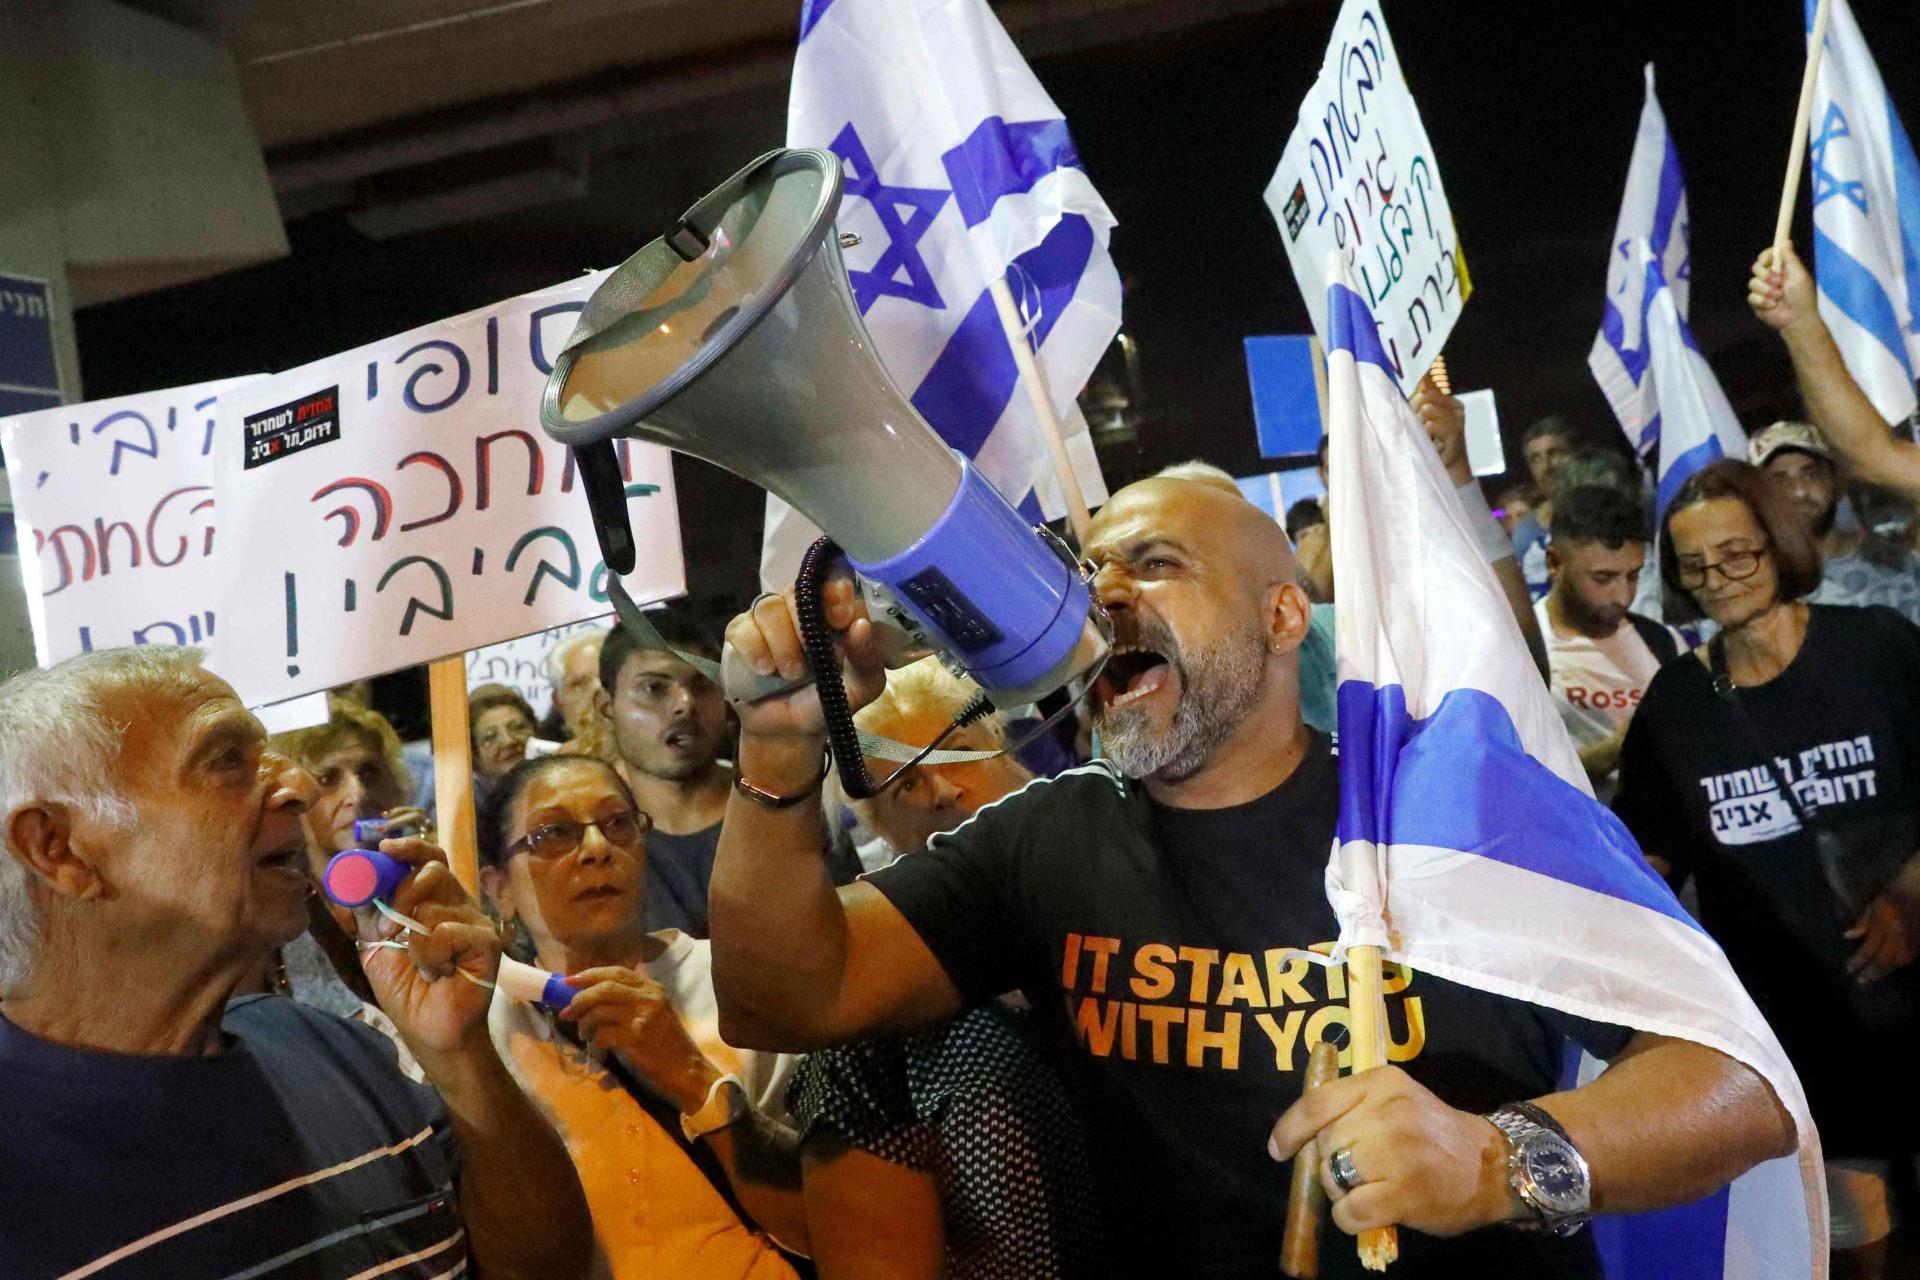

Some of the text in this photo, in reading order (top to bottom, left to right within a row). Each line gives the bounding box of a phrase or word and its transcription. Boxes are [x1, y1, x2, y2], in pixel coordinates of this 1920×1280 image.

[1309, 9, 1384, 226] הבטחת
[1361, 155, 1432, 309] קיבלנו
[250, 408, 294, 437] לשחרור
[251, 420, 332, 461] דרום תל אביב
[1798, 735, 1875, 777] החזית
[1711, 800, 1772, 831] אביב
[1062, 933, 1121, 993] IT
[1067, 996, 1426, 1072] WITH YOU
